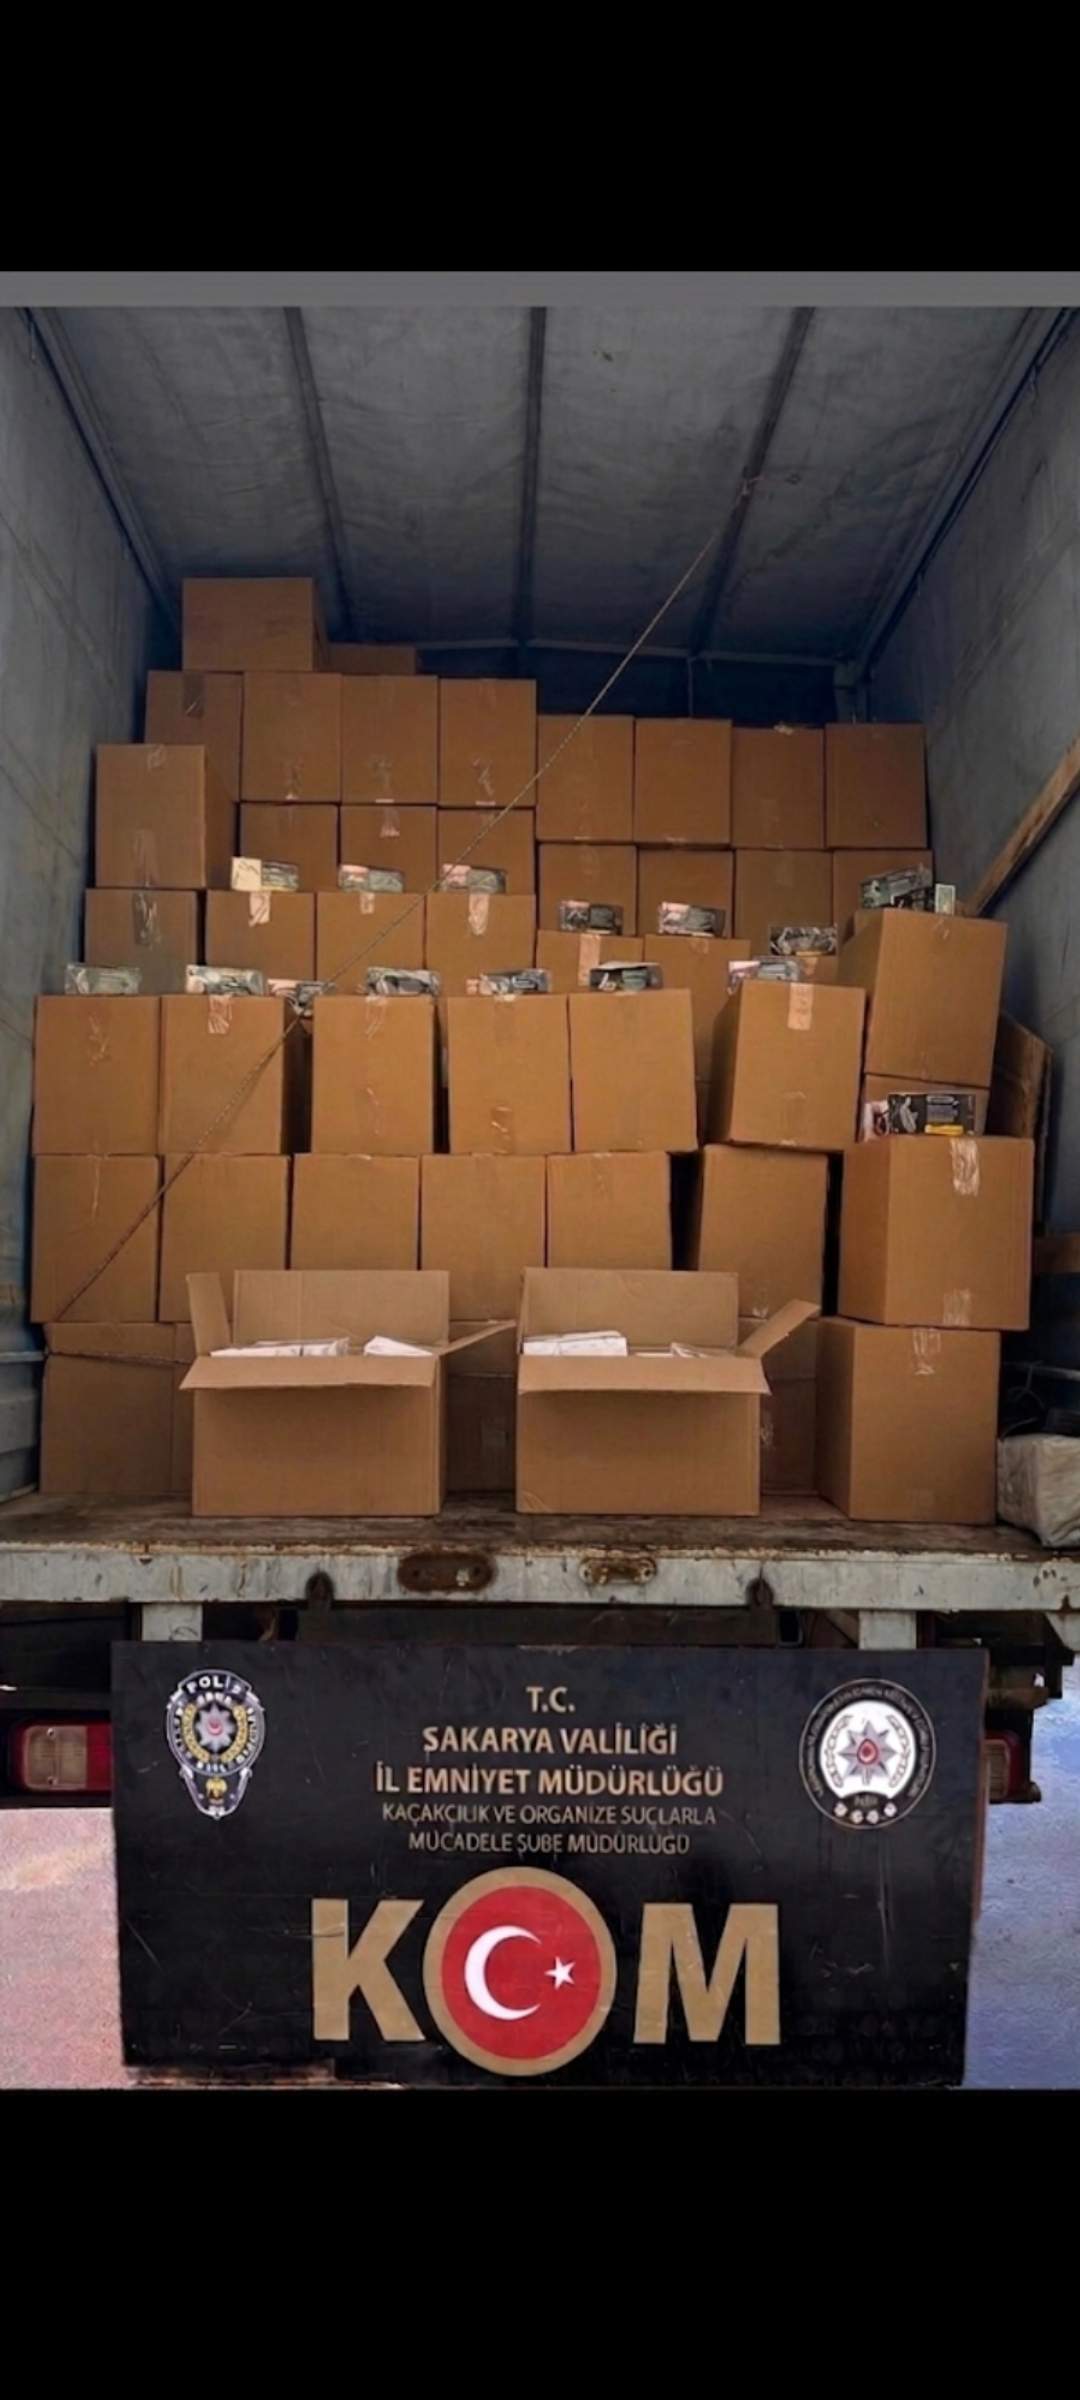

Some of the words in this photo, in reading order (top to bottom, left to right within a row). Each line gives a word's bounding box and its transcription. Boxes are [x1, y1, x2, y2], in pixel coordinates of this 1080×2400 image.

[525, 1686, 576, 1713] T.C.
[560, 1722, 678, 1755] VALİLİĞİ
[375, 1760, 400, 1792] İL
[407, 1762, 531, 1794] EMNİYET
[537, 1764, 723, 1796] MÜDÜRLÜĞÜ
[493, 1805, 516, 1823] VE
